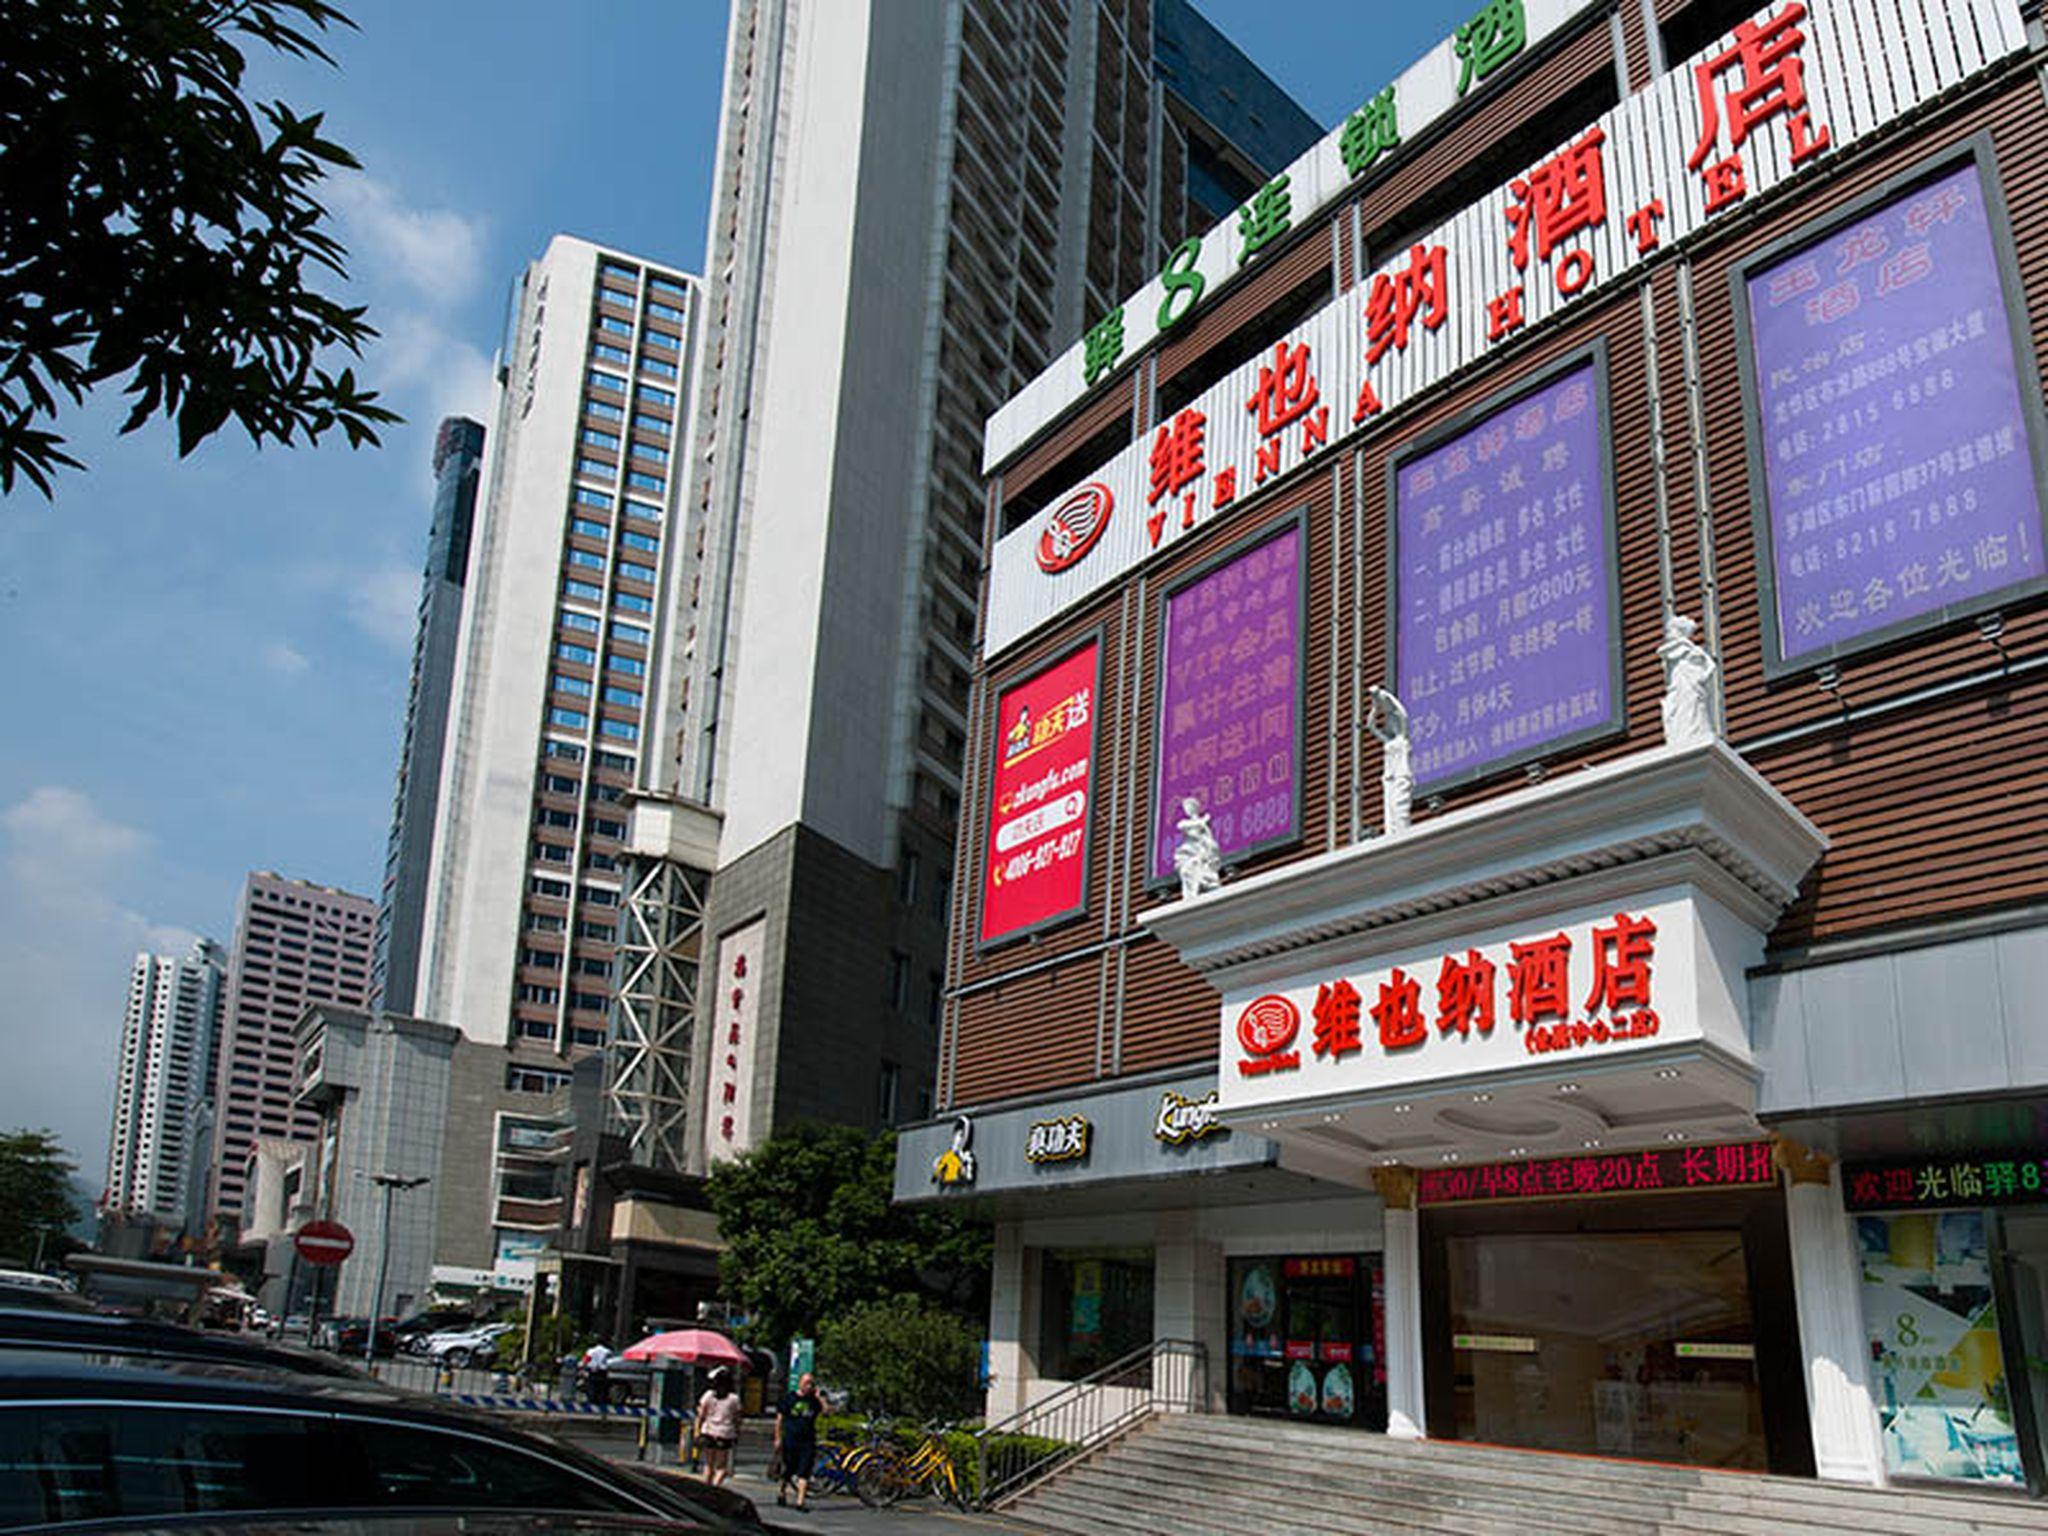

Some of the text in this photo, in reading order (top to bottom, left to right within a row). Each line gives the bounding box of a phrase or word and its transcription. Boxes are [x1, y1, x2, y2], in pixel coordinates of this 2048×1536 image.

[1147, 2, 1807, 505] 维也纳酒店
[1147, 112, 1831, 548] VIENNA HOTEL
[1310, 912, 1657, 1057] 维也纳酒店
[1851, 1161, 2048, 1203] 欢迎光临驿8
